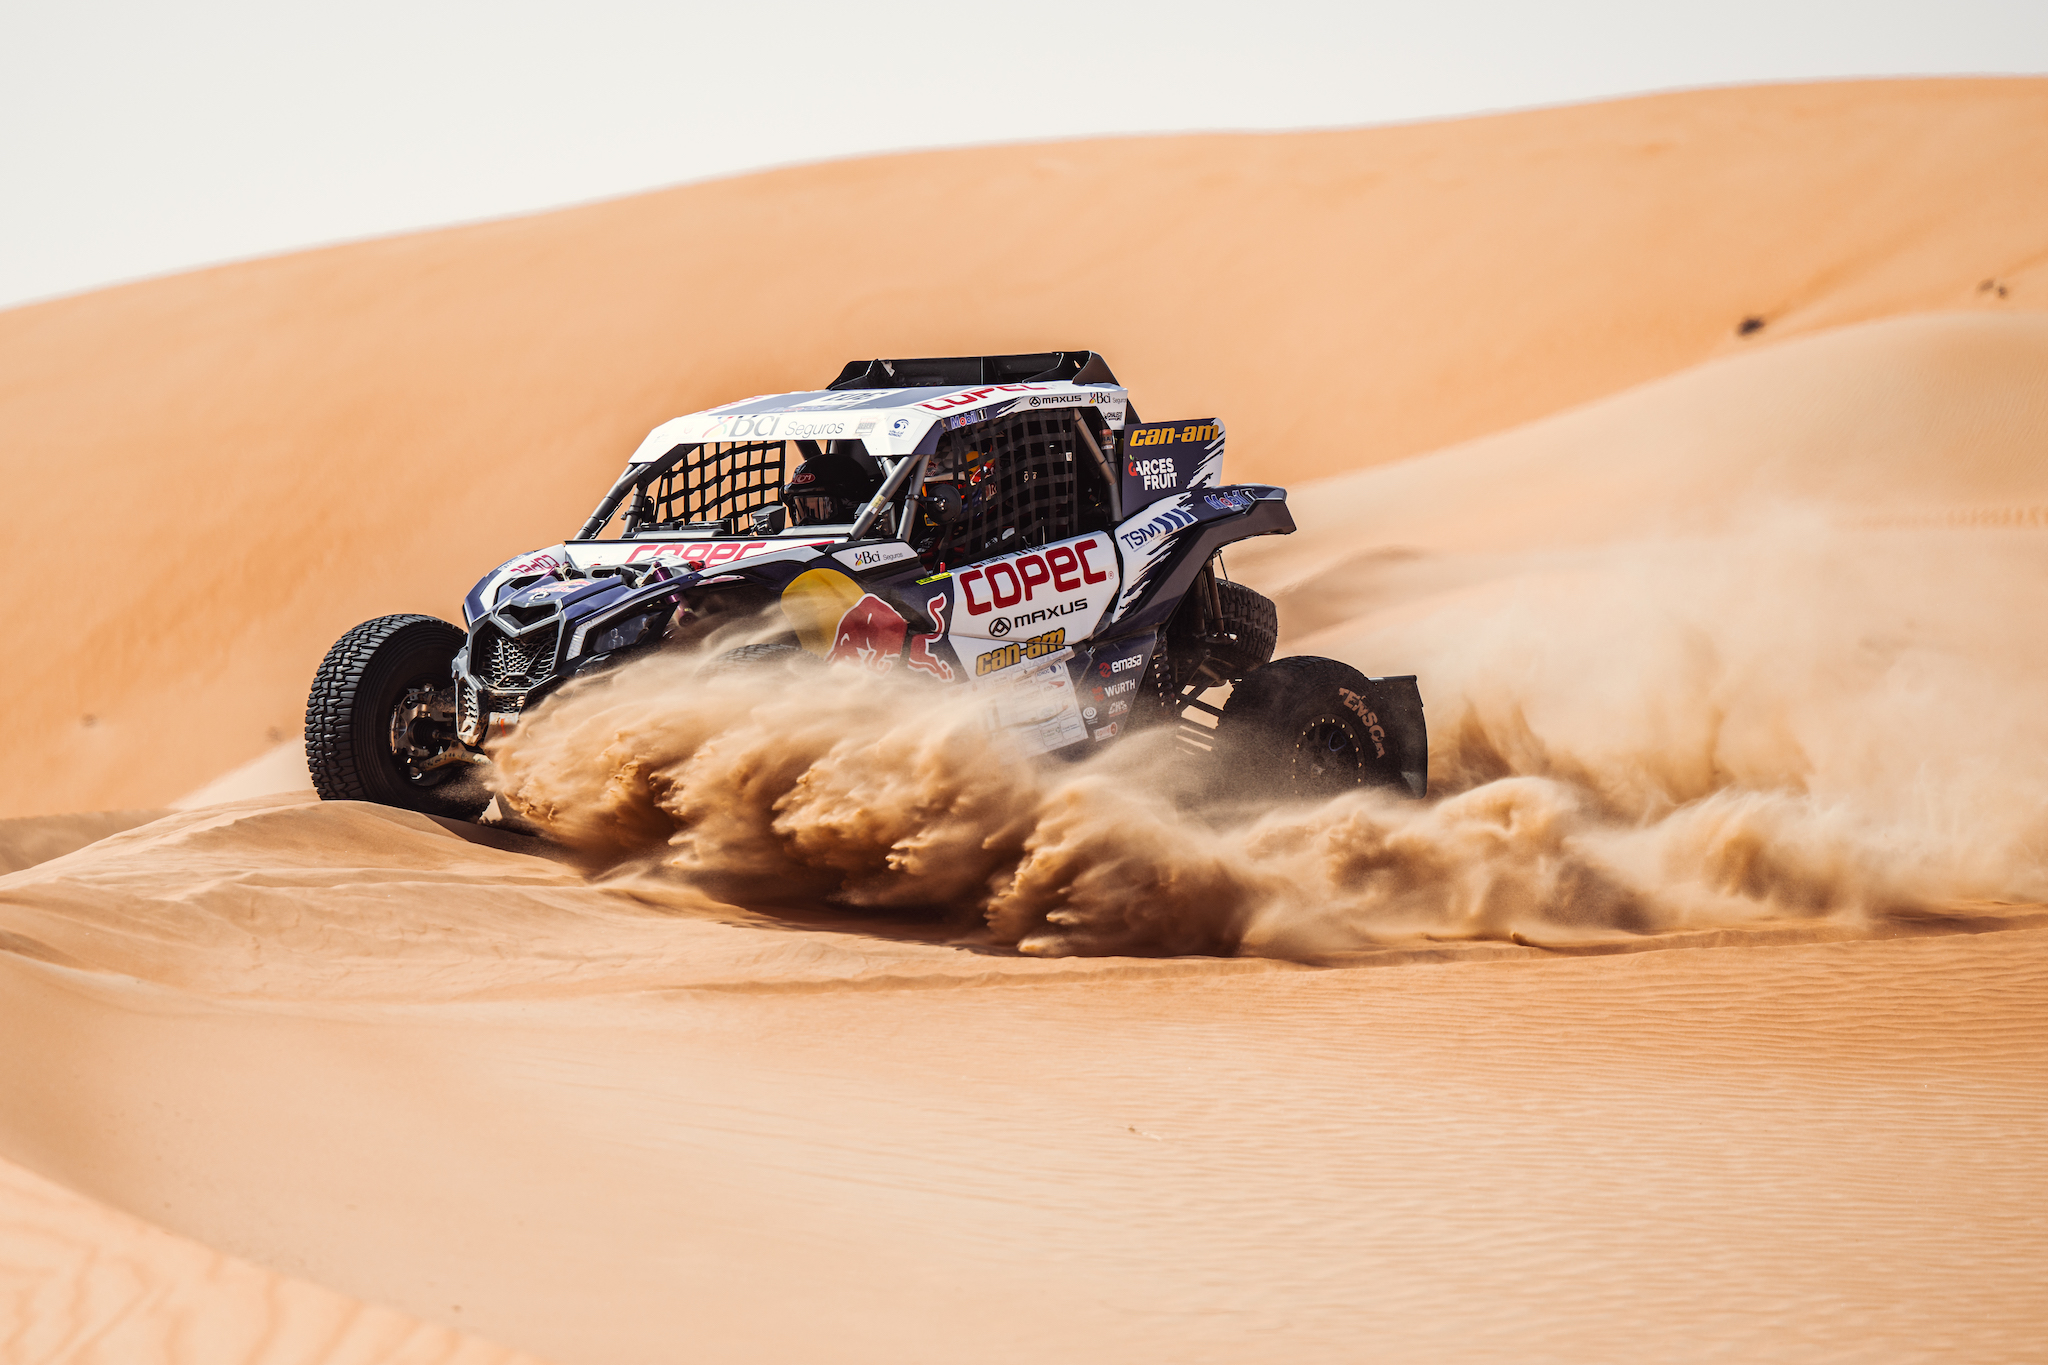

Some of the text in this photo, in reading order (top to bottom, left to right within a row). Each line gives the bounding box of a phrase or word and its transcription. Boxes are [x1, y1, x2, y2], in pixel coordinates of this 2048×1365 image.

[1042, 395, 1082, 405] MAXUS
[1096, 392, 1111, 404] Bci
[951, 408, 988, 429] Mobil 1
[785, 421, 845, 438] Seguros
[1129, 424, 1219, 447] can-am
[1144, 472, 1178, 490] FRUIT
[1204, 489, 1249, 511] Mobil
[1120, 523, 1161, 549] TSM
[862, 550, 881, 565] Bci
[1014, 598, 1088, 628] MAXUS
[976, 627, 1066, 677] can-am
[1111, 654, 1142, 673] emasa
